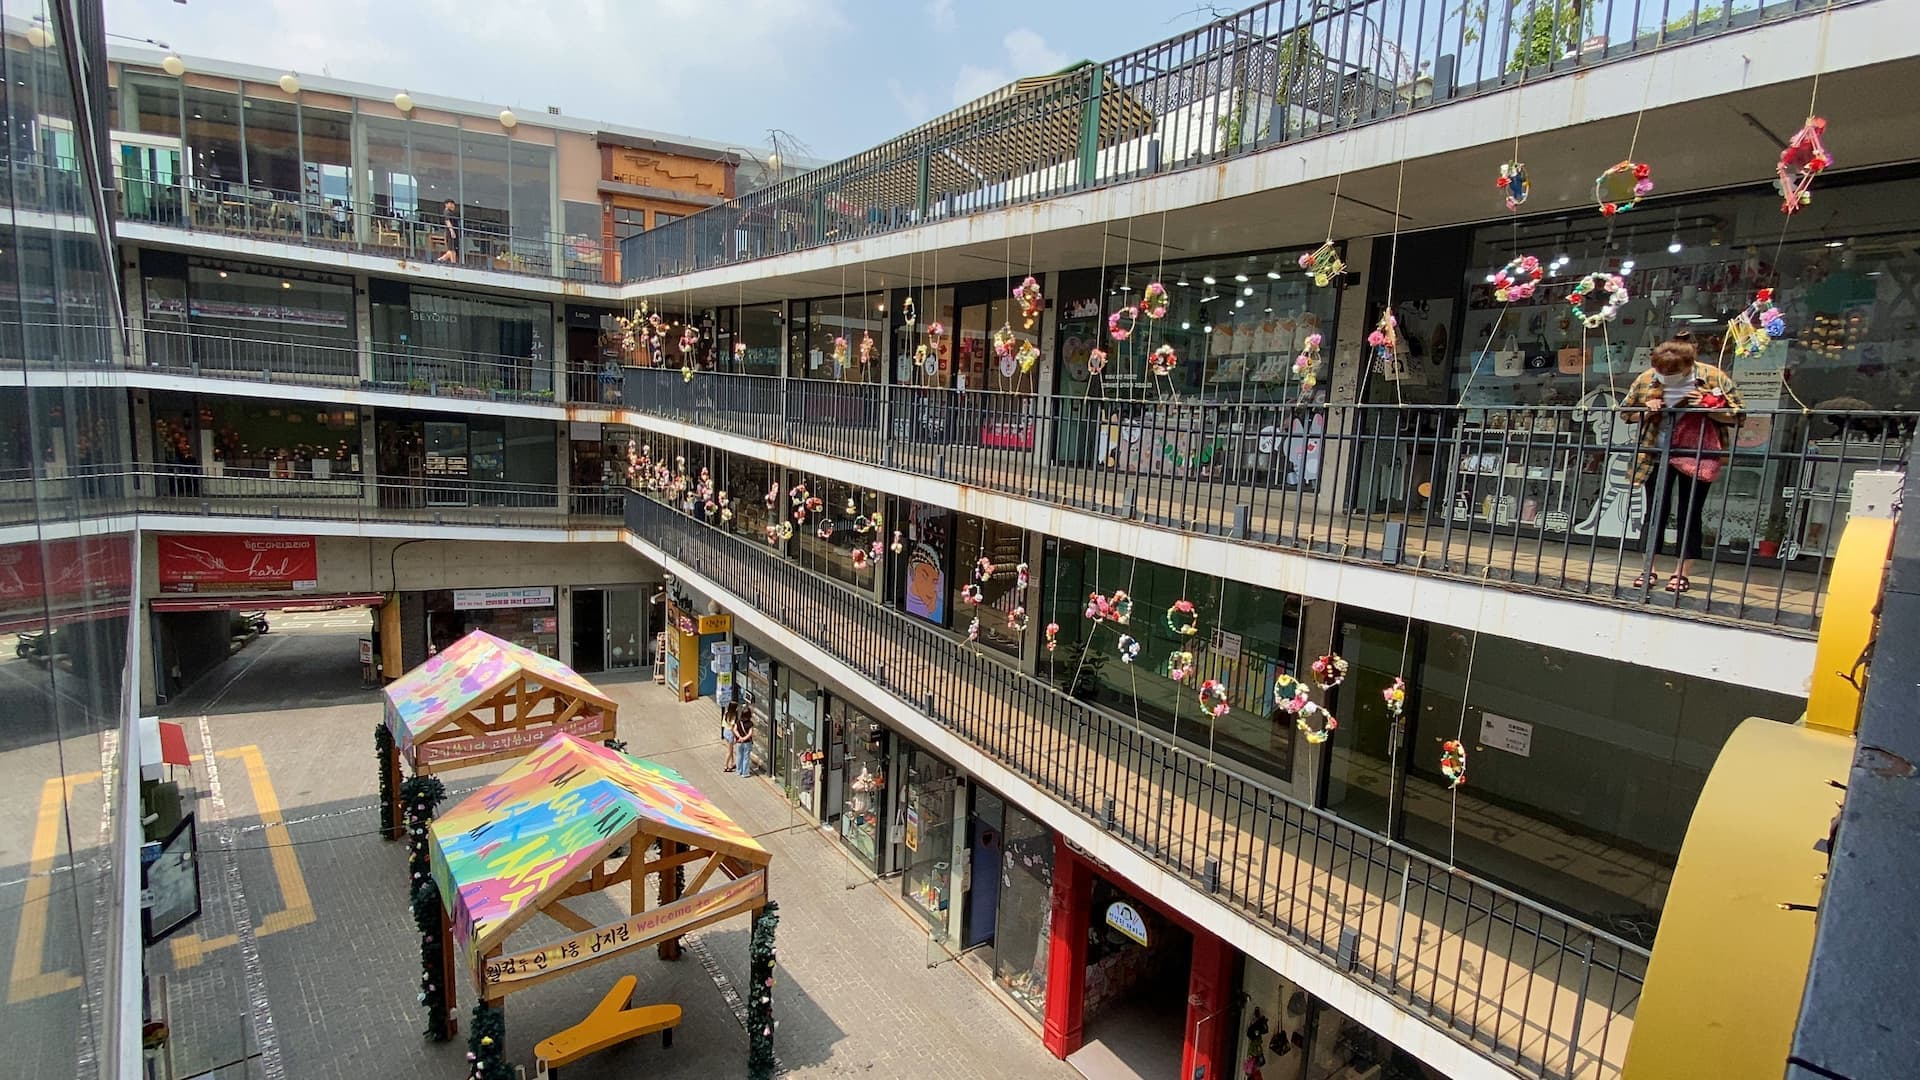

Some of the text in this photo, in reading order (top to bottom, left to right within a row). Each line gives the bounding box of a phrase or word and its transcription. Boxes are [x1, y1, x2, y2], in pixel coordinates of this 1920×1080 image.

[412, 312, 457, 323] BEYOND
[248, 552, 290, 577] hand
[636, 906, 692, 933] Welcome
[485, 957, 516, 983] 웰컴
